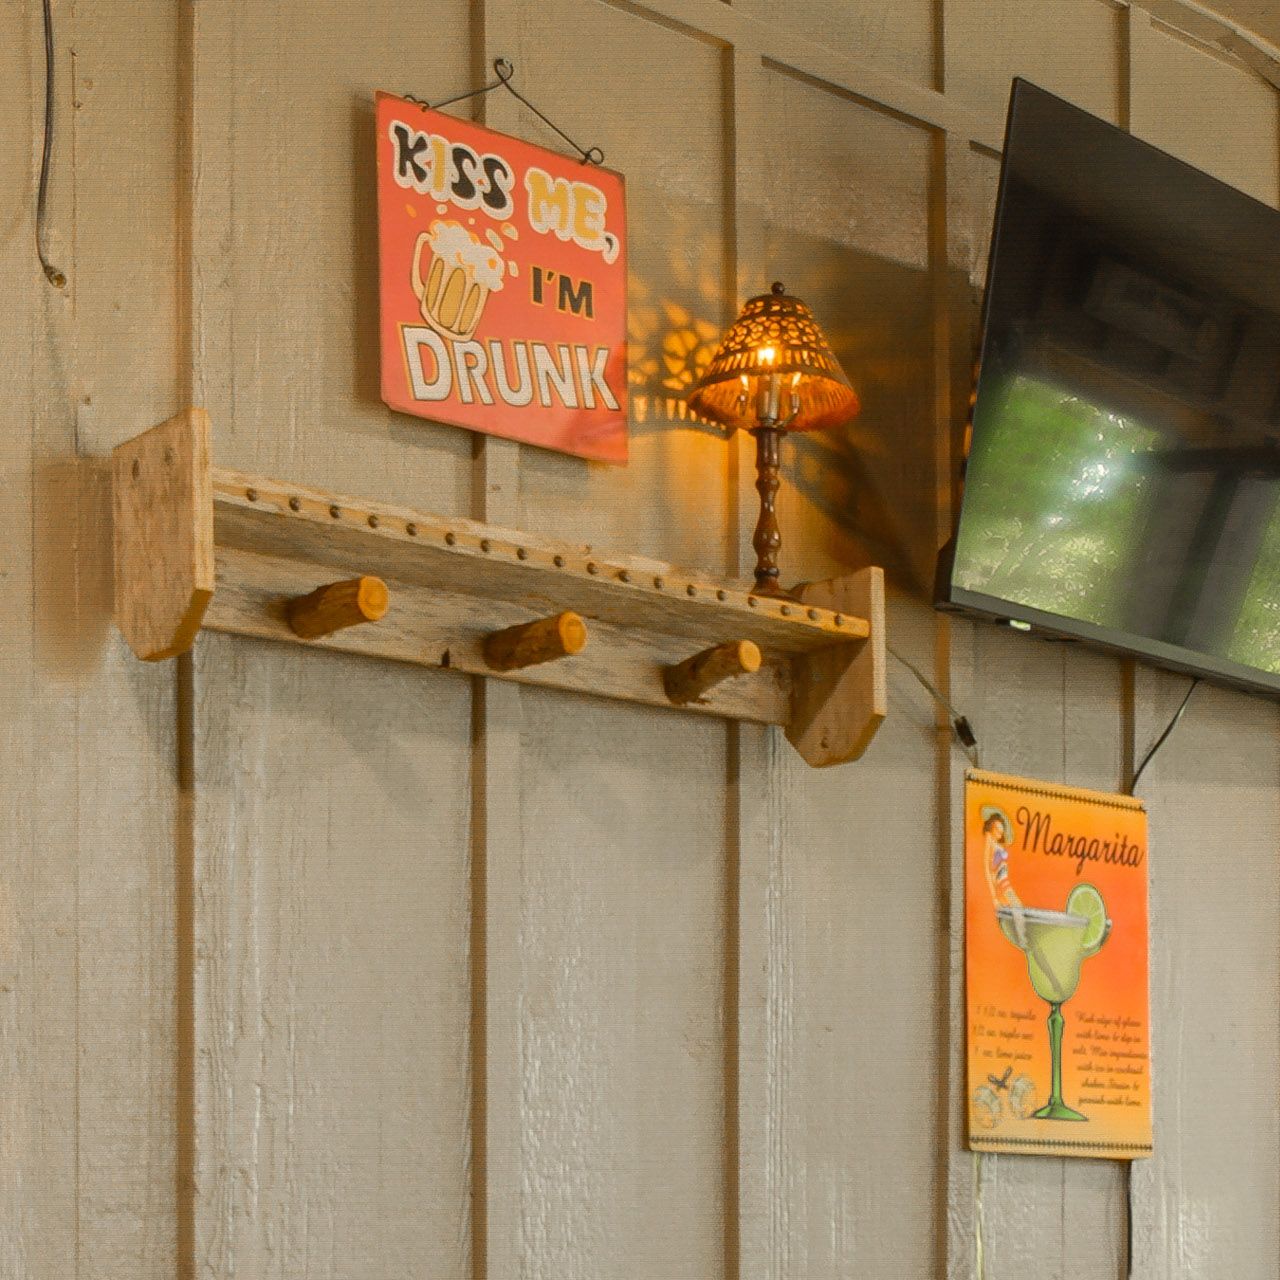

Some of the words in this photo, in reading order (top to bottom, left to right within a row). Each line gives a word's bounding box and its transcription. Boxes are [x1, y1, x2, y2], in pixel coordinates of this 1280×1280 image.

[390, 121, 515, 220] KISS
[525, 168, 619, 264] ME,
[530, 265, 594, 319] I'M
[398, 322, 620, 411] DRUNK
[1016, 806, 1144, 876] Margarita
